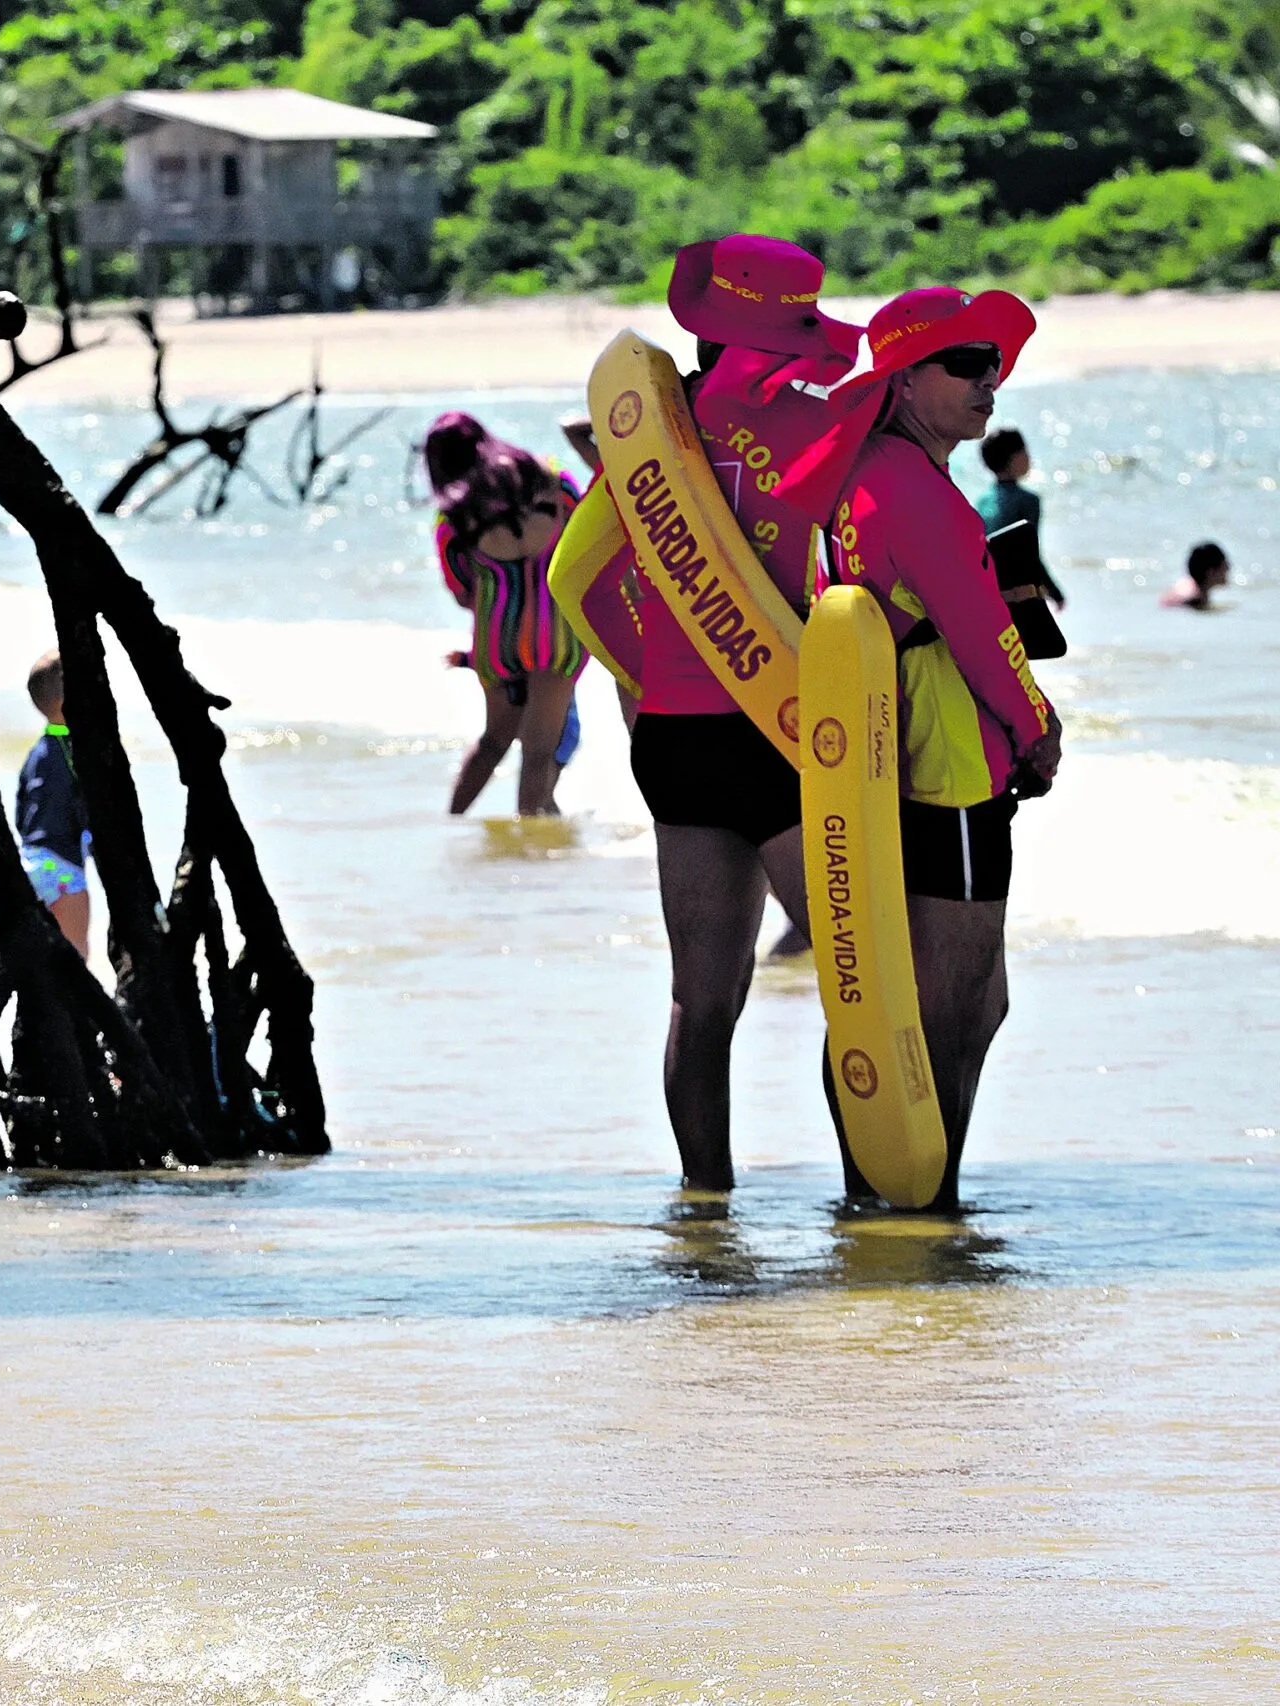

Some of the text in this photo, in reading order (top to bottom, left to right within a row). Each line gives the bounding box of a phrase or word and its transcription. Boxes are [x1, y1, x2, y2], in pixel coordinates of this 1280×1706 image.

[725, 422, 782, 493] ROS
[626, 458, 772, 681] GUARDA-VIDAS
[837, 500, 865, 576] ROS
[823, 814, 862, 1005] GUARDA-VIDAS
